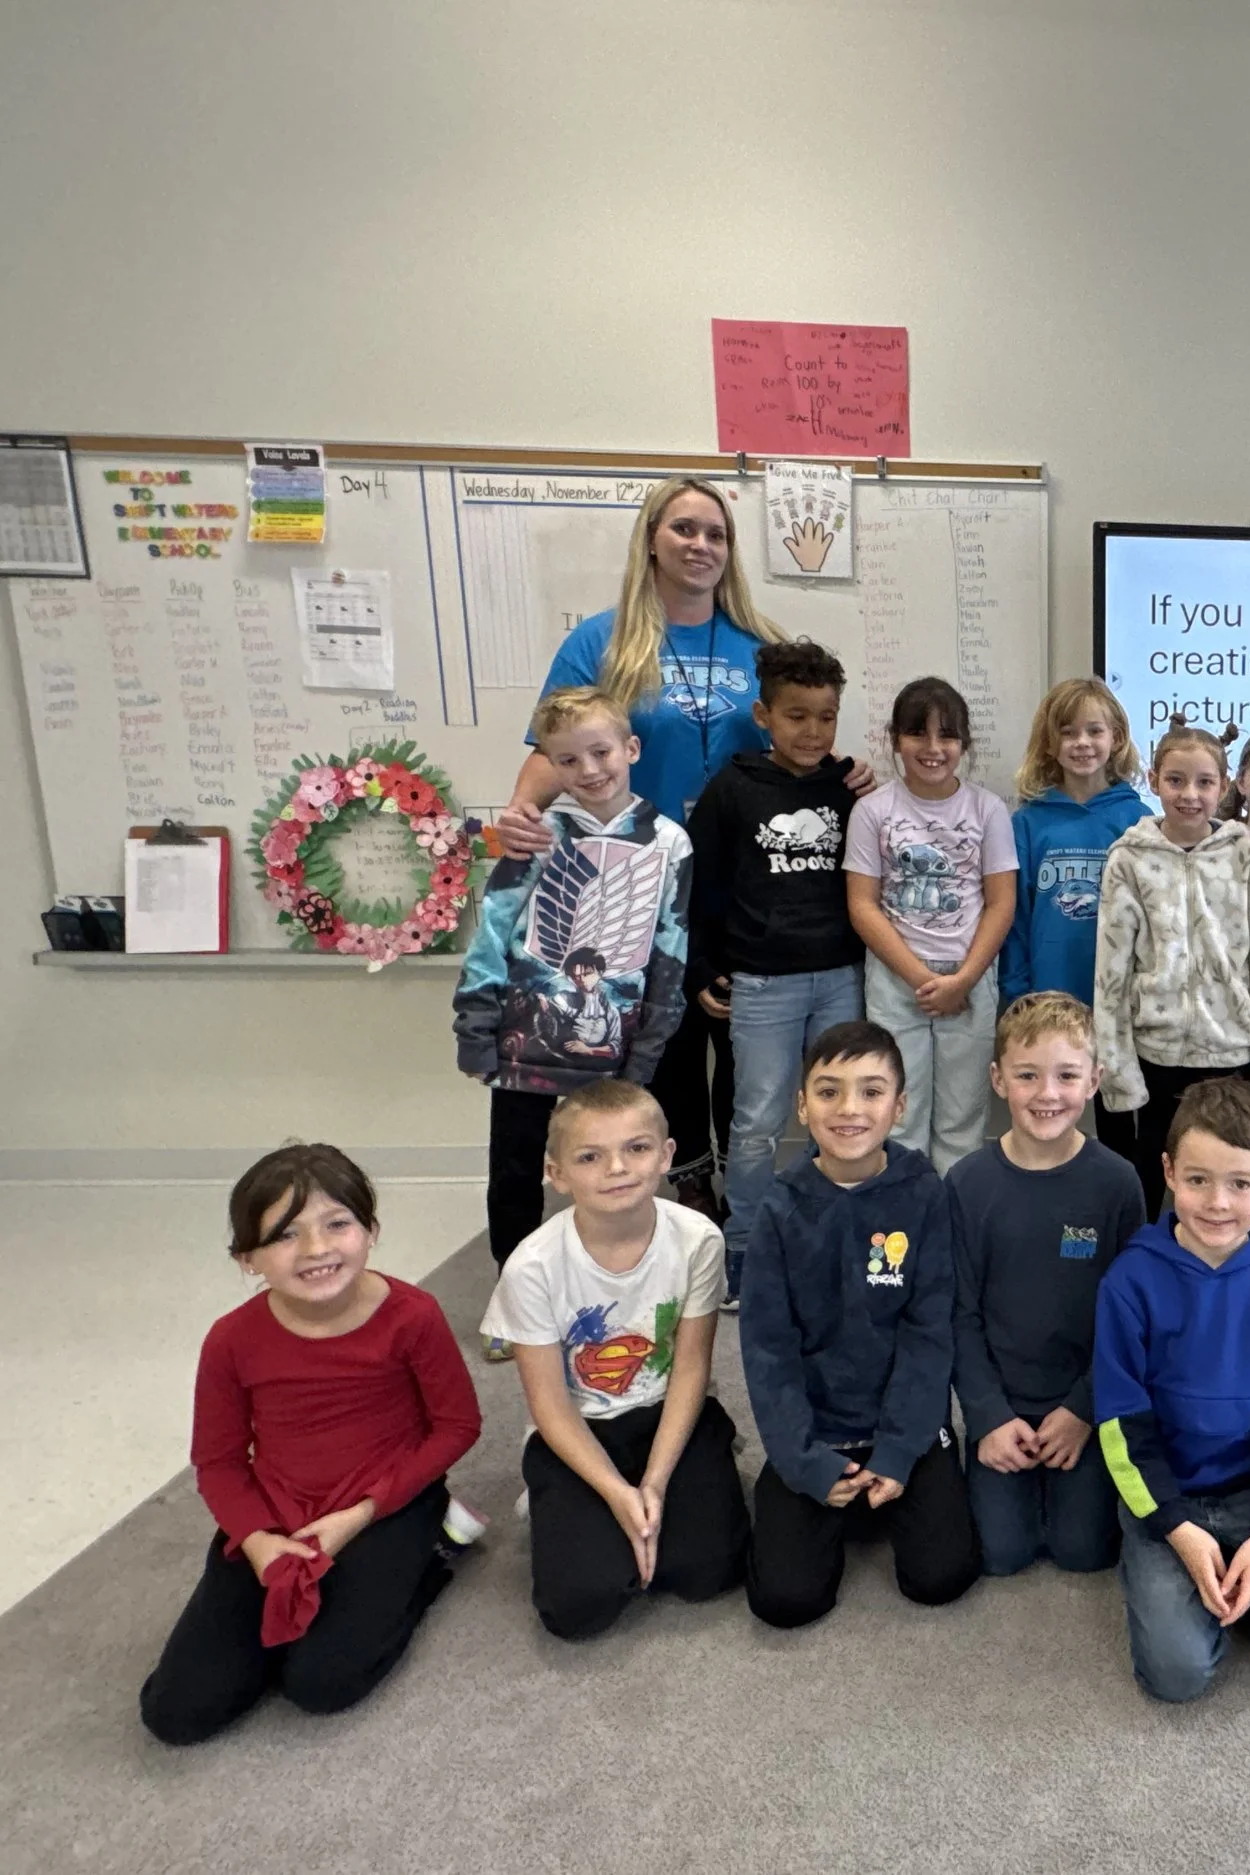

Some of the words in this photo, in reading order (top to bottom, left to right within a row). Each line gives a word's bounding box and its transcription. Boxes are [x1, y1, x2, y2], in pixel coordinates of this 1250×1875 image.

[784, 354, 825, 372] Count
[834, 355, 848, 371] to
[796, 375, 819, 390] 100
[827, 374, 841, 394] by
[130, 487, 154, 502] TO
[340, 475, 370, 499] Day
[374, 470, 388, 499] 4
[546, 480, 612, 501] November
[1151, 593, 1172, 626] If
[1181, 602, 1242, 633] you
[660, 664, 751, 693] TTERS
[768, 853, 836, 873] Roots
[1037, 860, 1107, 891] OTTE
